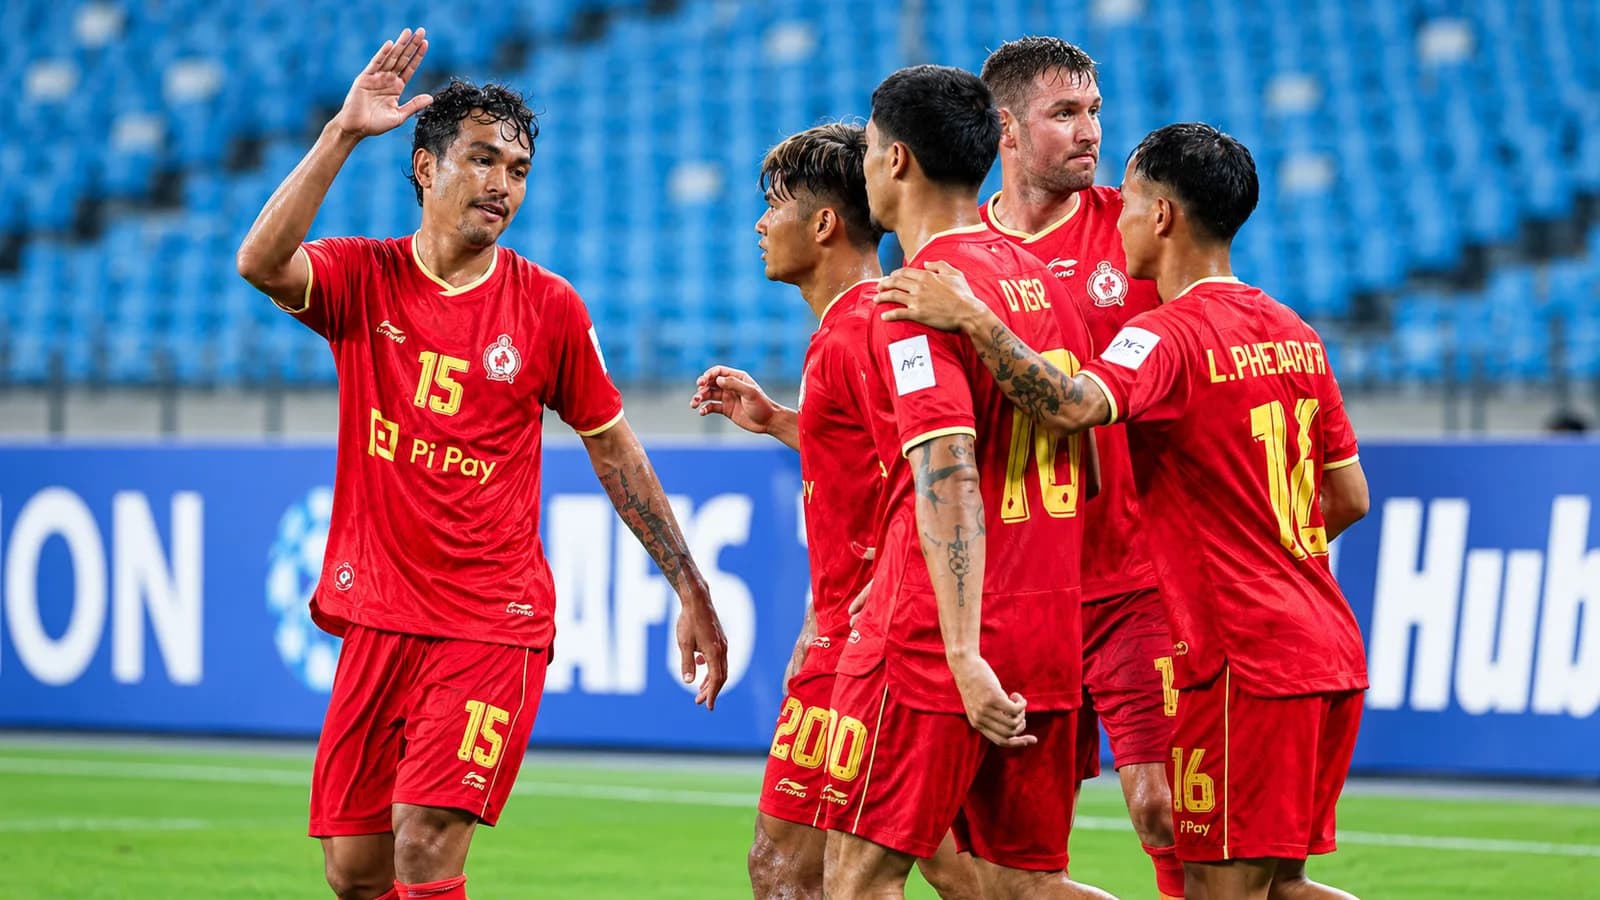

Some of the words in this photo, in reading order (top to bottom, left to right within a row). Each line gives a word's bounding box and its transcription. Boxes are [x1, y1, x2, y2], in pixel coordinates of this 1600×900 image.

[413, 351, 470, 416] 15
[410, 439, 435, 469] Pi
[442, 446, 497, 485] Pay
[0, 486, 204, 687] ON
[1365, 495, 1600, 718] Hub
[457, 699, 510, 769] 15
[770, 696, 830, 769] 20
[1171, 747, 1216, 813] 16
[1186, 820, 1210, 836] Pay
